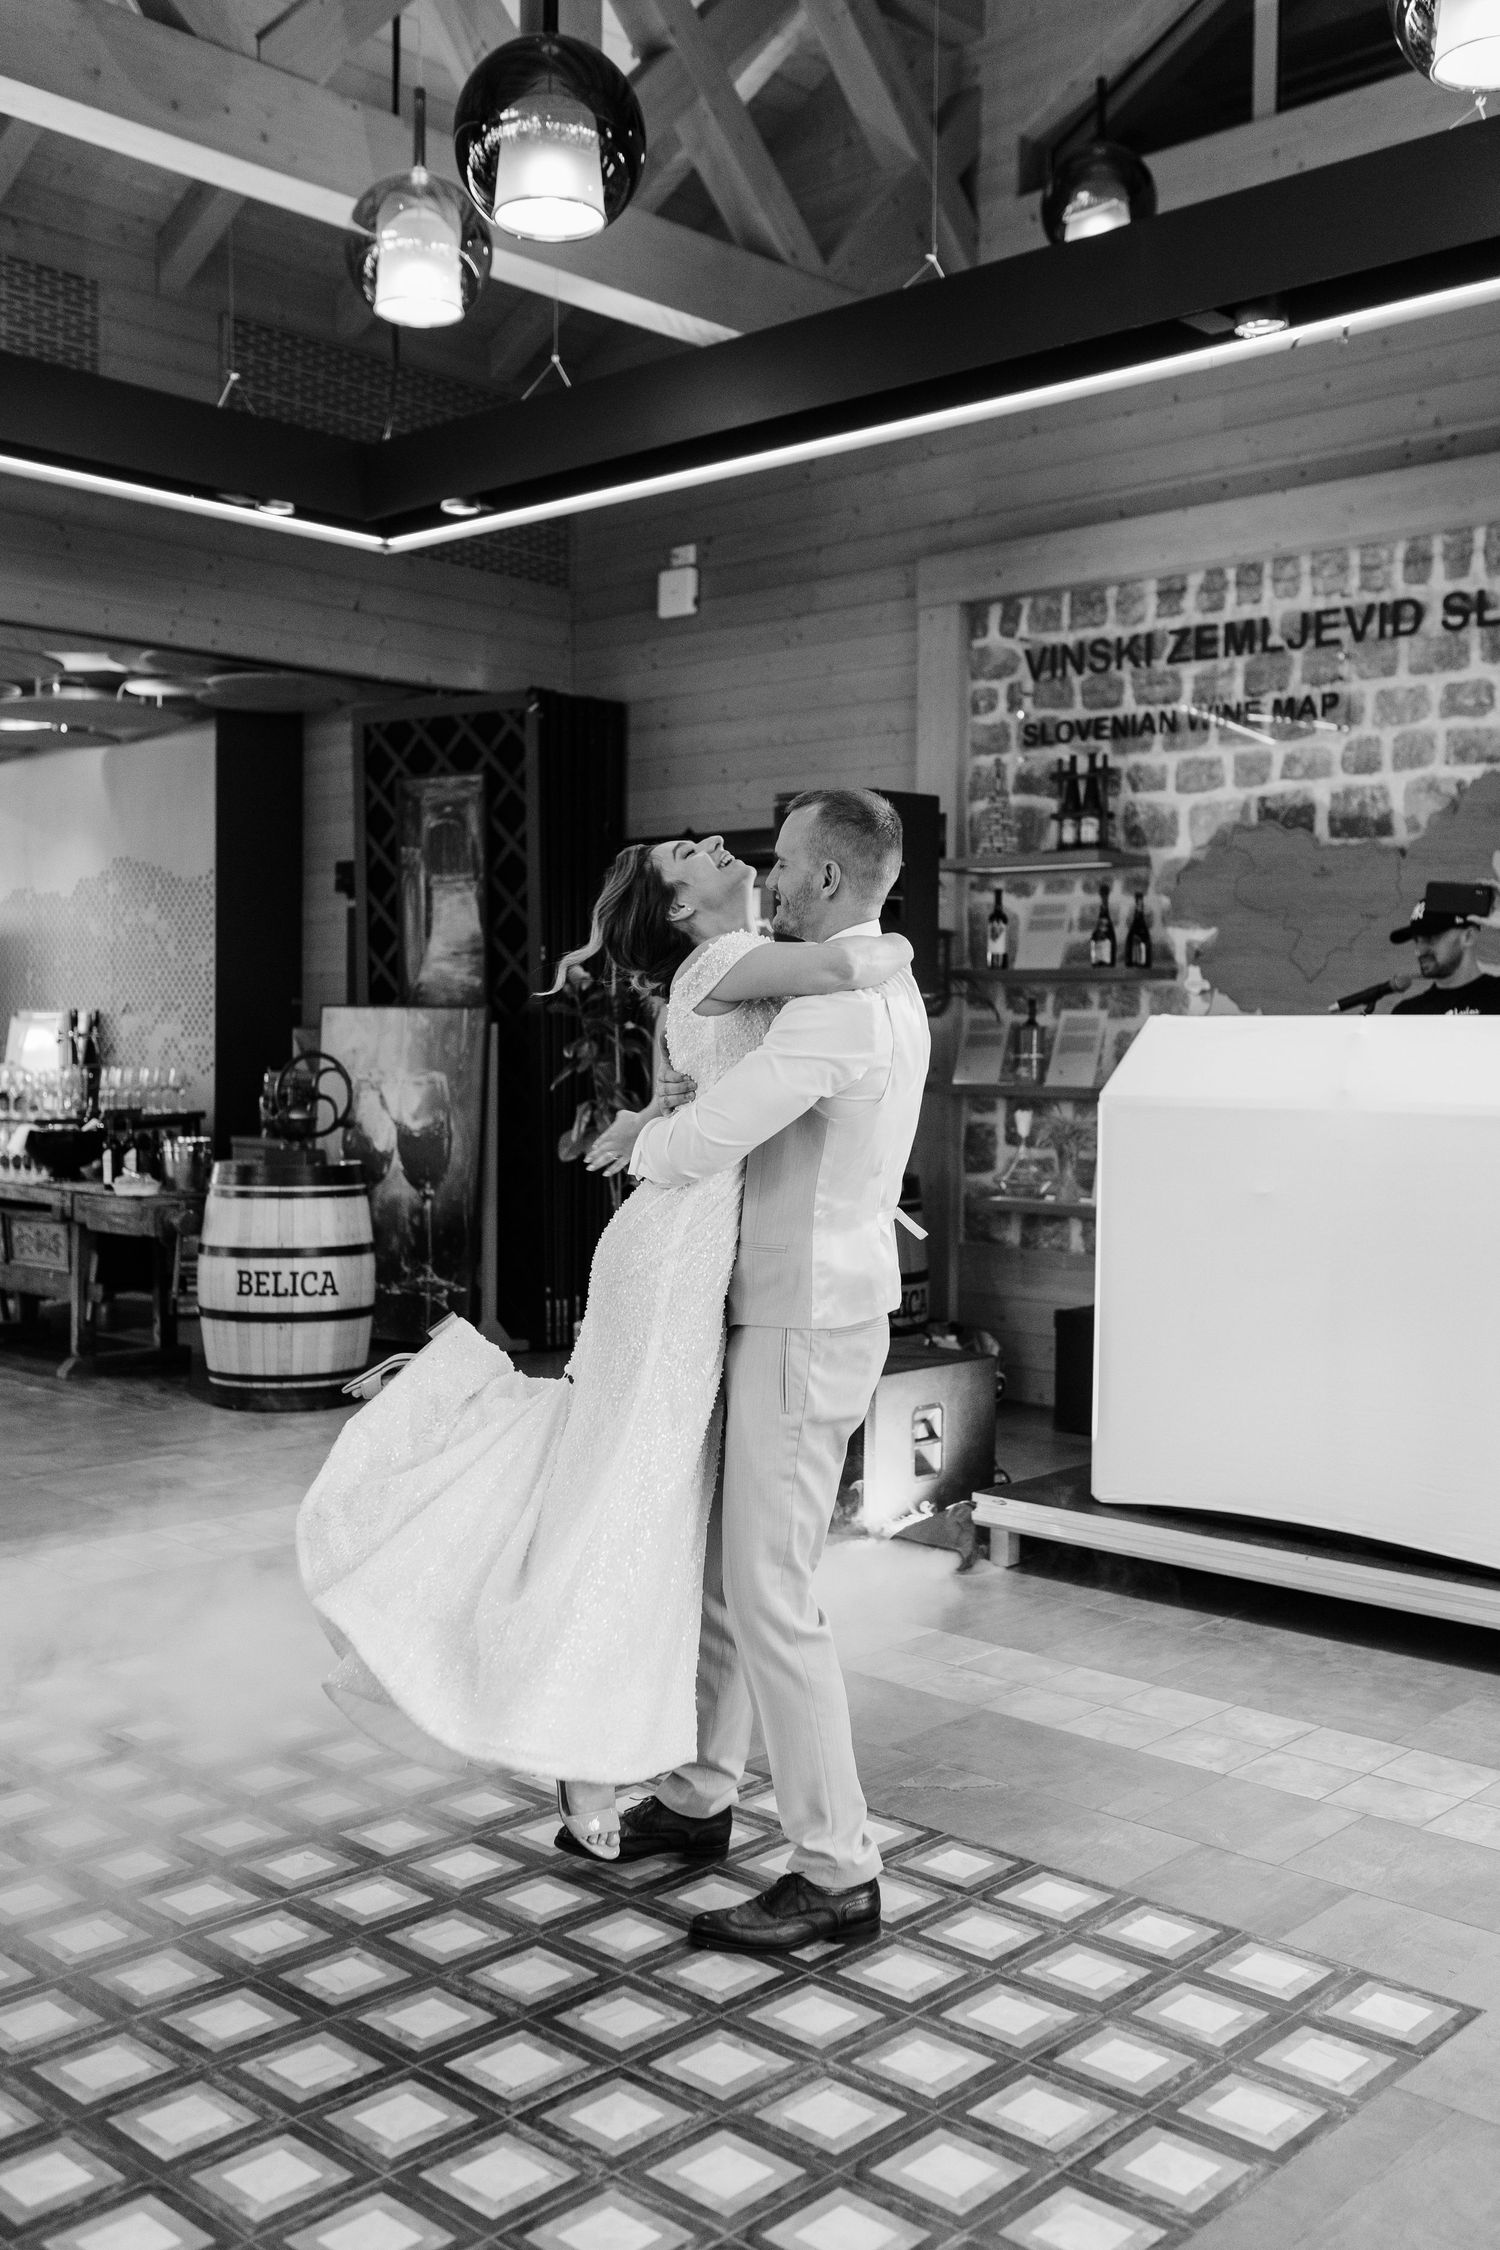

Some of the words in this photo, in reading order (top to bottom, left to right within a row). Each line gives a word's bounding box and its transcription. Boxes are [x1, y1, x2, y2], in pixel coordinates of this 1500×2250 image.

[1024, 632, 1151, 682] VINSKI
[1166, 597, 1425, 664] ZEMLJEVID
[1022, 710, 1177, 747] SLOVENIAN
[1272, 692, 1340, 722] MAP
[236, 1269, 339, 1297] BELICA
